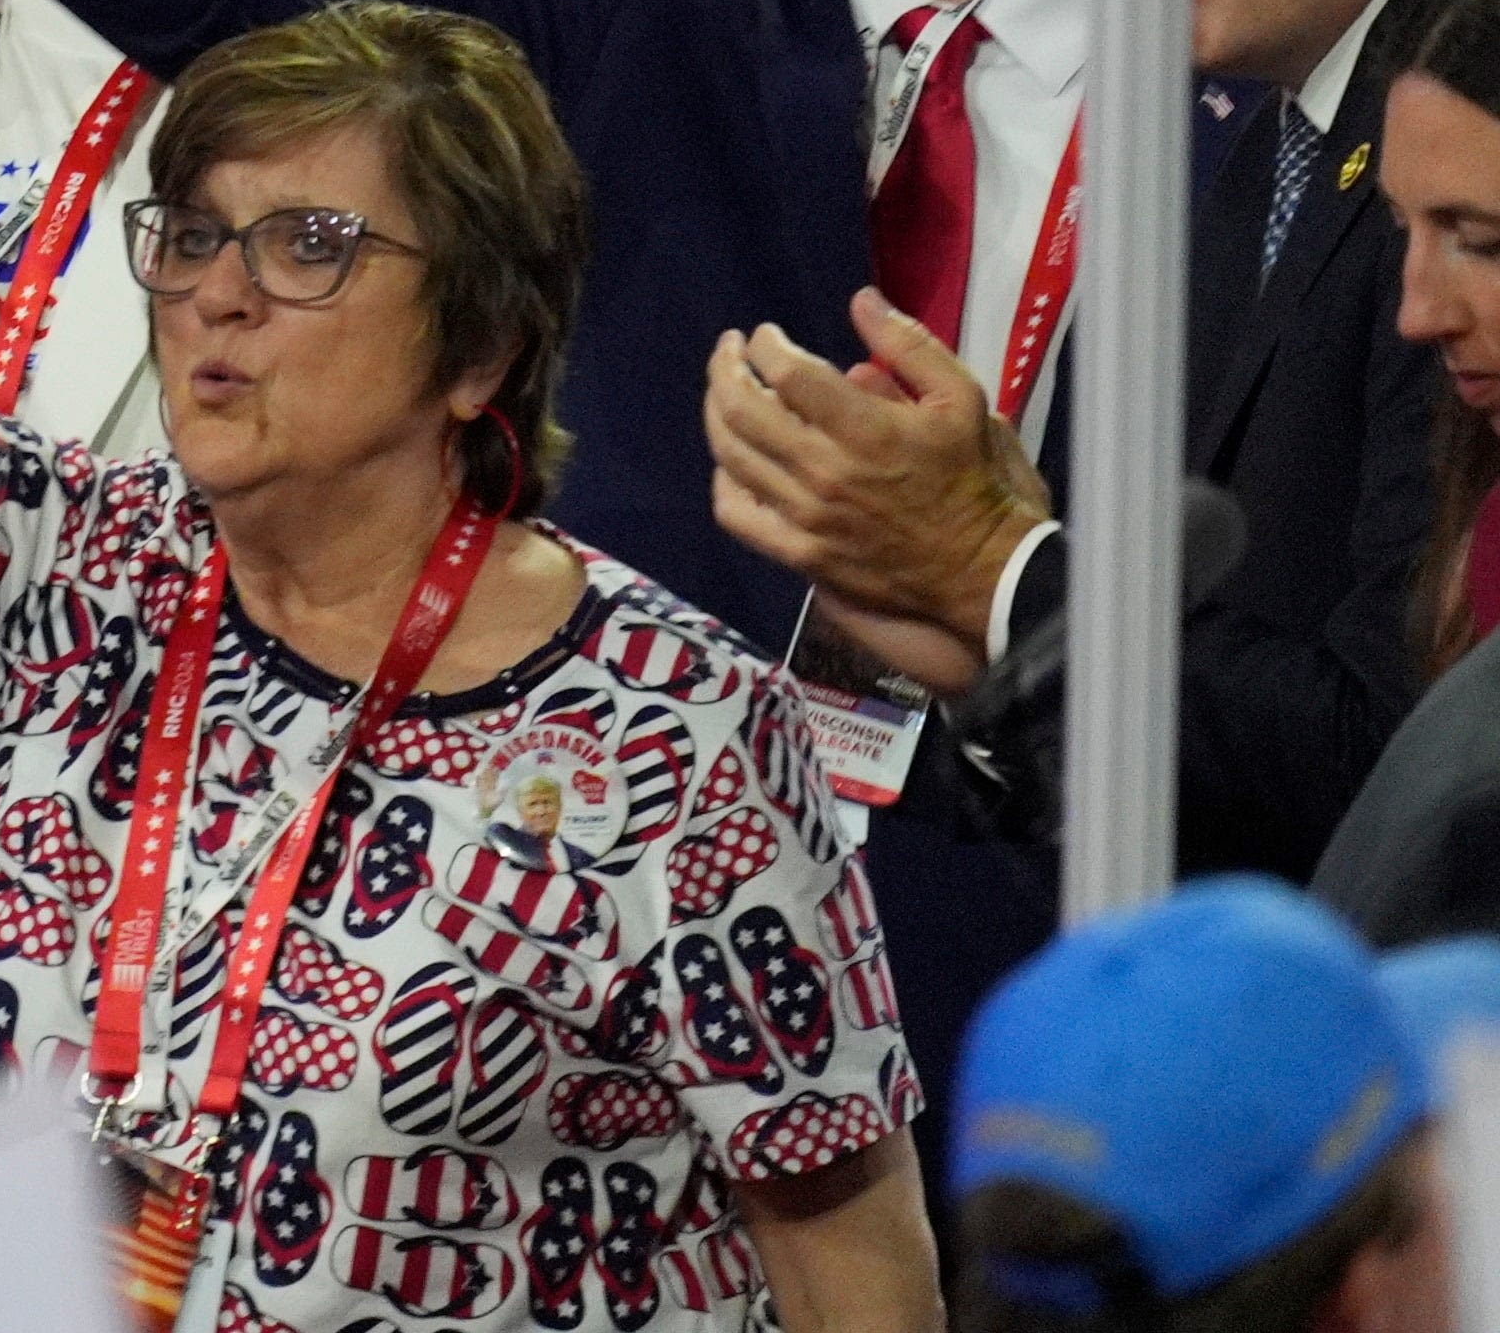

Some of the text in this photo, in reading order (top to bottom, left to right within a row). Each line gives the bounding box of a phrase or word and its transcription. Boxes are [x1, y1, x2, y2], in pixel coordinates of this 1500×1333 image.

[37, 171, 87, 255] RNC2024
[162, 650, 197, 740] RNC2024
[816, 732, 883, 761] LEGATE
[114, 918, 136, 965] DATA
[133, 908, 155, 965] TRUST
